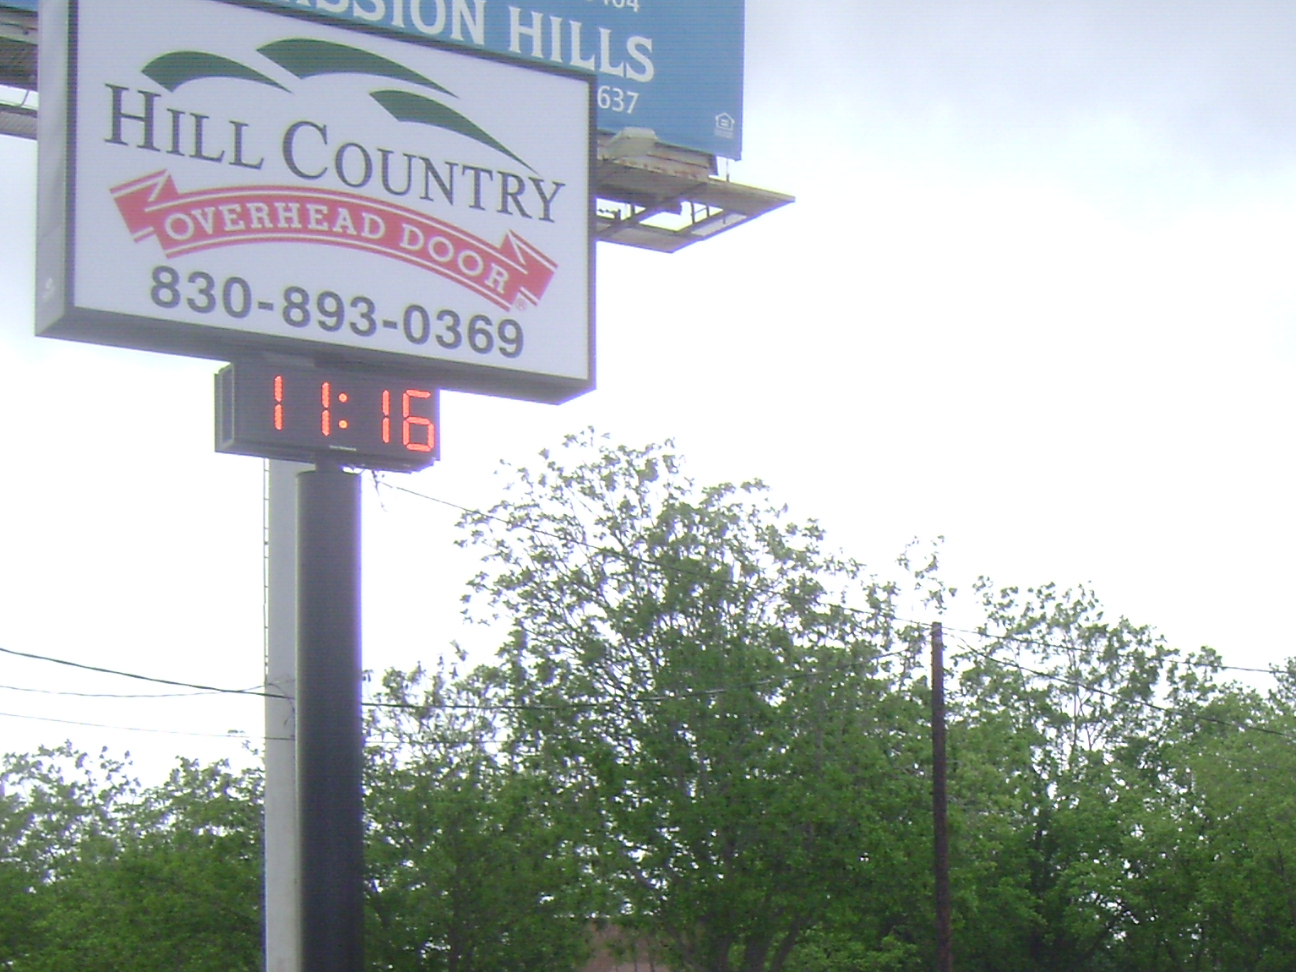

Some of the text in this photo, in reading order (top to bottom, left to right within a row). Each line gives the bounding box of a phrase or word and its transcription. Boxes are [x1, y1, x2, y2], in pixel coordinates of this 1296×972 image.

[508, 6, 655, 83] HILLS
[104, 83, 566, 223] HILL COUNTRY
[164, 201, 510, 294] OVERHEAD DOOR
[151, 265, 524, 359] 830-893-0369
[274, 375, 435, 452] 11:16
